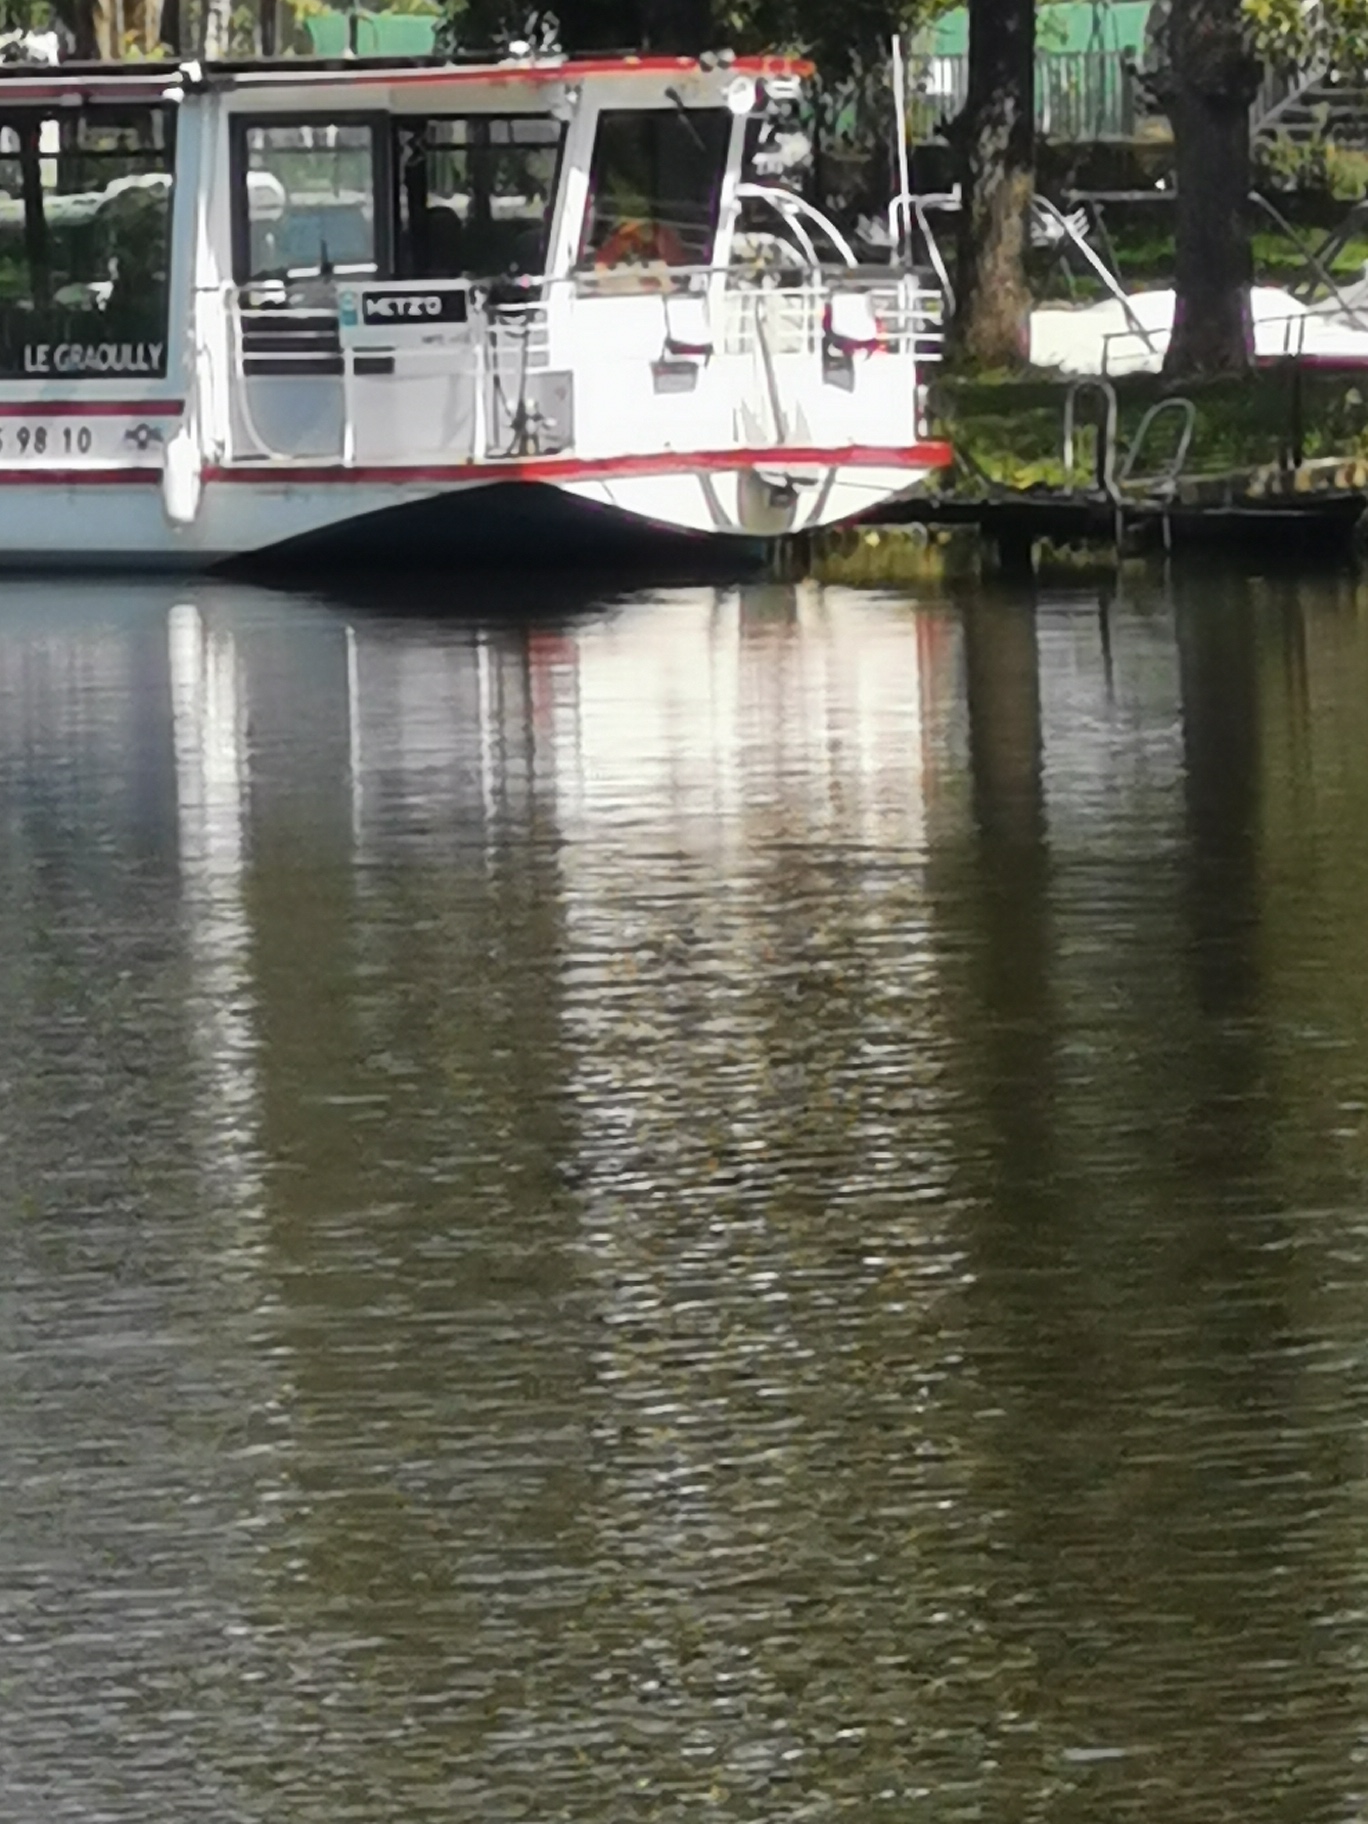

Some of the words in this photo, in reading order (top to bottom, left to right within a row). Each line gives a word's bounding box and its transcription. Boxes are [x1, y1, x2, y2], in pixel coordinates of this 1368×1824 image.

[24, 343, 50, 372] LE
[53, 342, 163, 372] GRAOULLY
[17, 427, 48, 455] 98
[63, 427, 93, 455] 10
